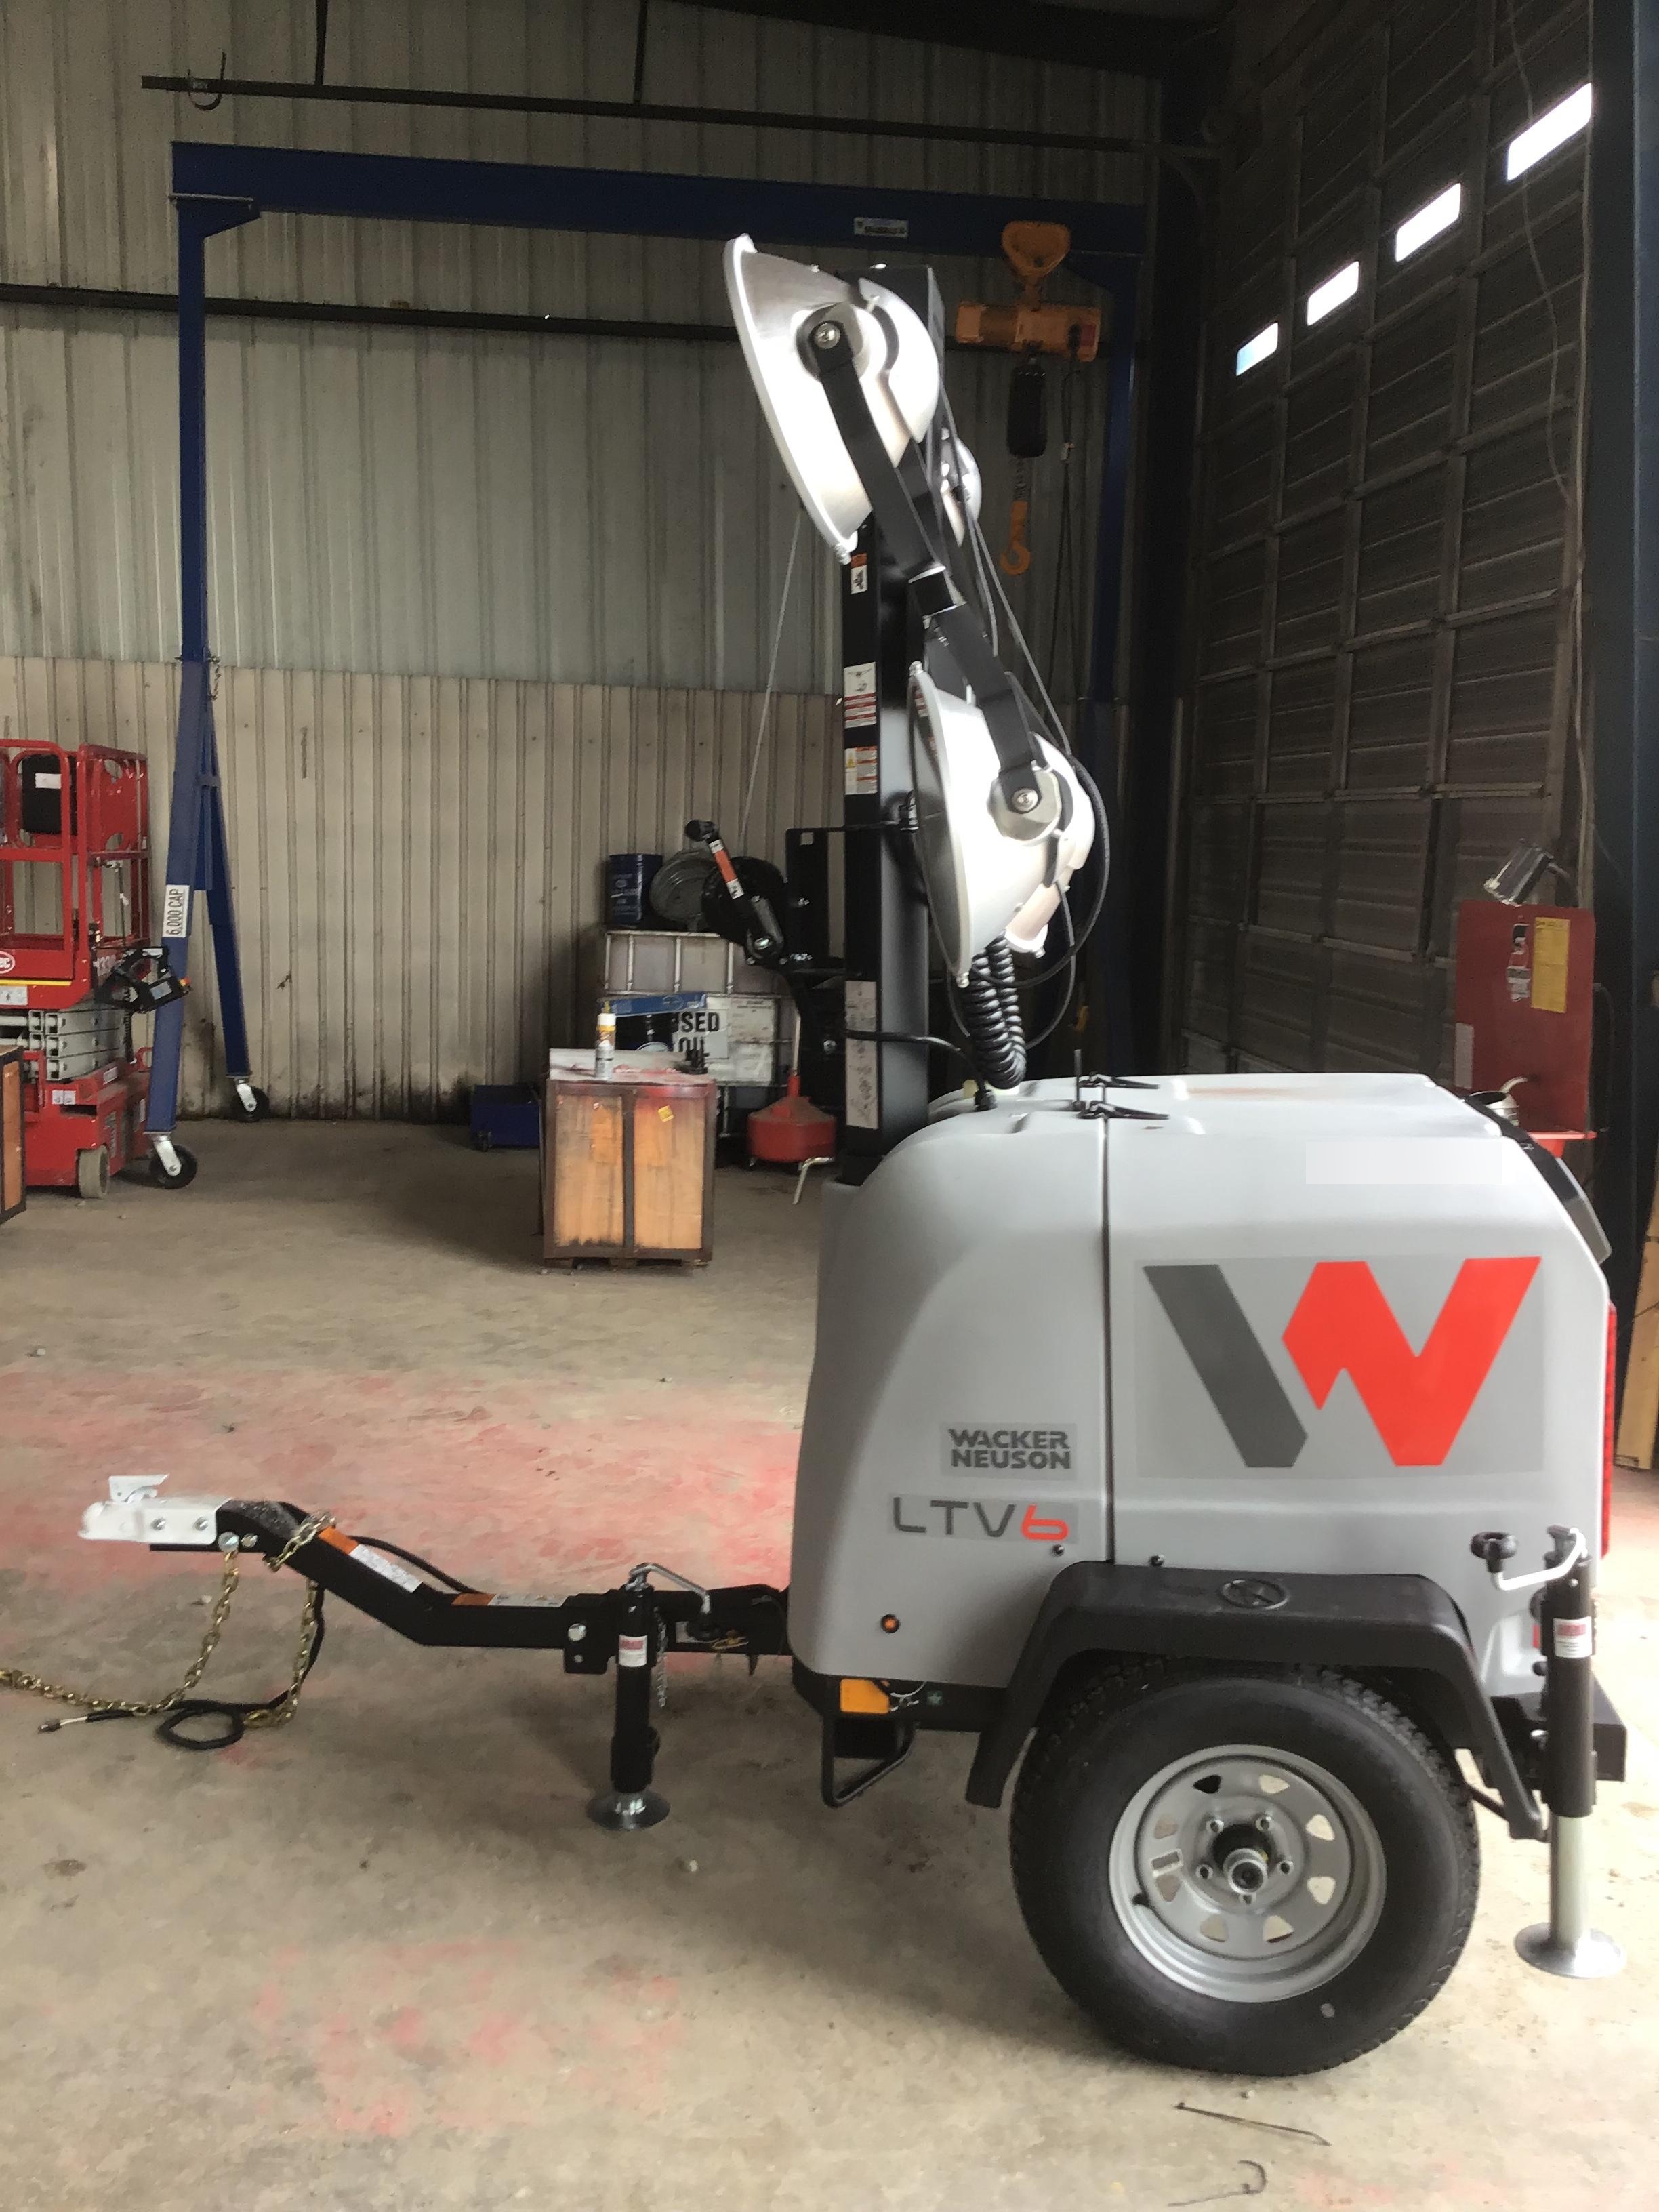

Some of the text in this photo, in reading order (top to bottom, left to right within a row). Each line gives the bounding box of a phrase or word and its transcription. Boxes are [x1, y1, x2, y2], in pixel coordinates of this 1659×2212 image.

[168, 888, 184, 908] CAP
[948, 1428, 1070, 1449] WACKER
[951, 1448, 1071, 1469] NEUSON
[893, 1496, 1070, 1541] LTV6
